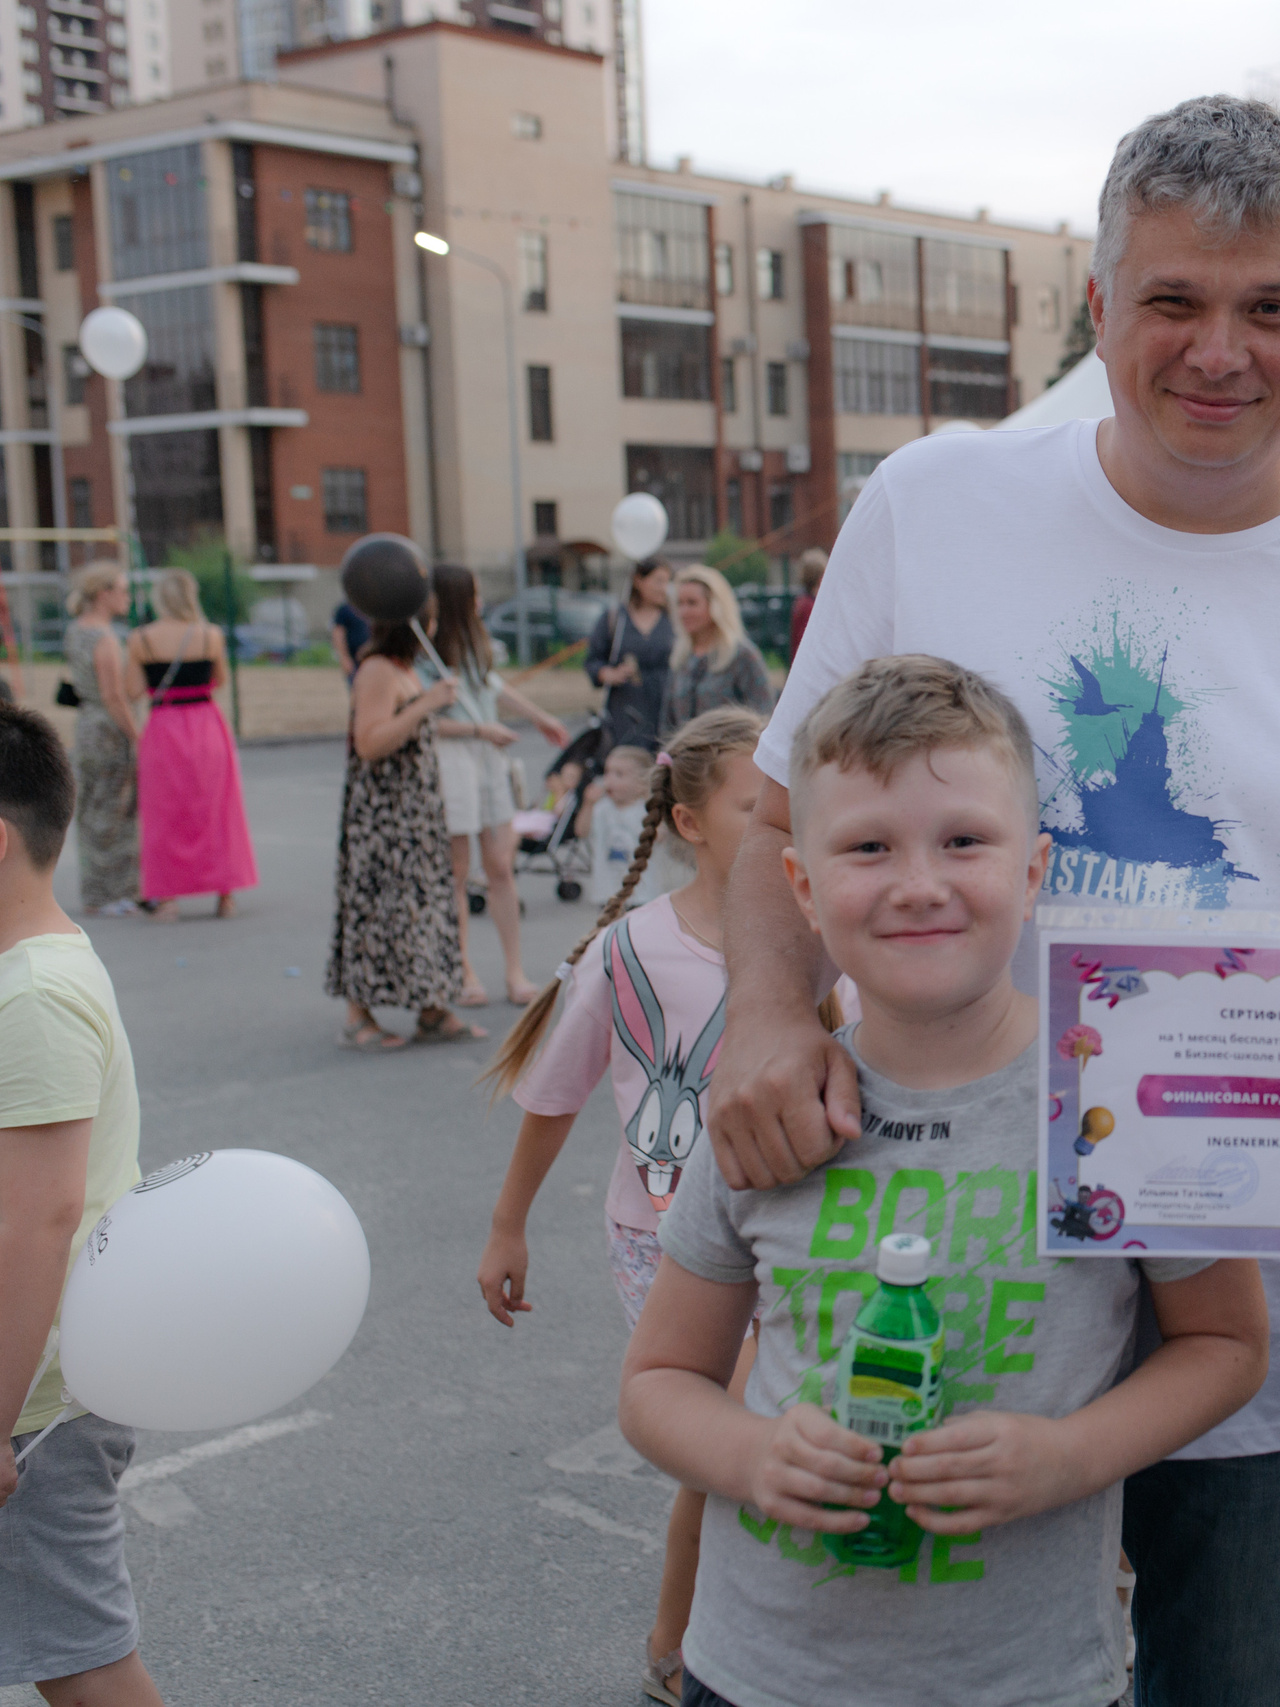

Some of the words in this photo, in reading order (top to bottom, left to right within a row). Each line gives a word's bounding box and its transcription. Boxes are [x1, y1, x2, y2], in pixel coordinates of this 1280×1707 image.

[1159, 1034, 1174, 1043] на
[1187, 1034, 1227, 1045] месяц
[1185, 1049, 1275, 1062] Бизнес-школе
[1161, 1090, 1261, 1105] ФИНАНСОВАЯ
[878, 1120, 926, 1141] MOVE
[929, 1120, 951, 1140] ON
